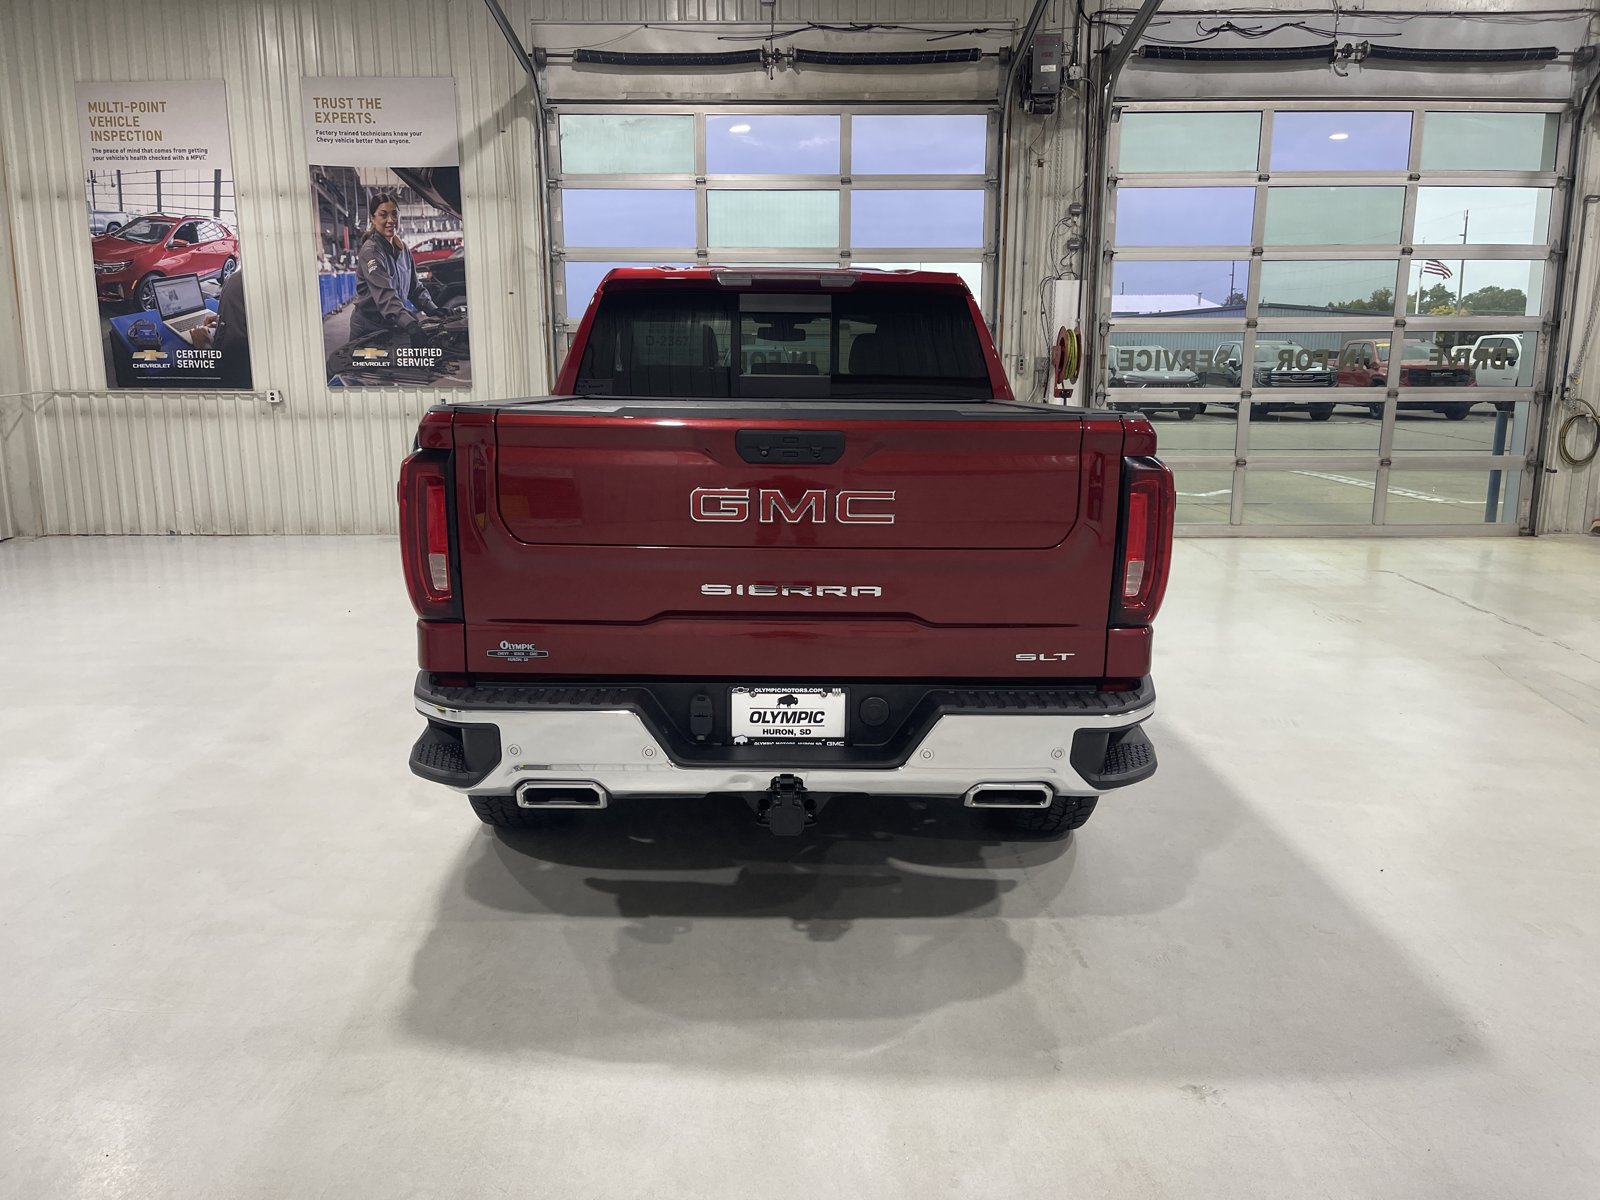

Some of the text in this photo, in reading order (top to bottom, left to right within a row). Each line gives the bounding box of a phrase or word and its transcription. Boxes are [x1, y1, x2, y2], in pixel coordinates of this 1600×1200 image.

[88, 101, 166, 113] MULTI-POINT
[313, 97, 382, 109] TRUST THE
[89, 116, 140, 127] VEHICLE
[314, 112, 376, 124] EXPERTS.
[90, 130, 162, 141] INSPECTION
[176, 349, 222, 359] CERTIFIED
[396, 348, 442, 357] CERTIFIED
[176, 359, 215, 369] SERVICE
[396, 358, 435, 367] SERVICE
[690, 487, 896, 524] GMC
[701, 583, 882, 597] SIERRA
[1015, 653, 1075, 661] SLT
[749, 711, 825, 724] OLYMPIC
[762, 728, 812, 736] HURON, SD
